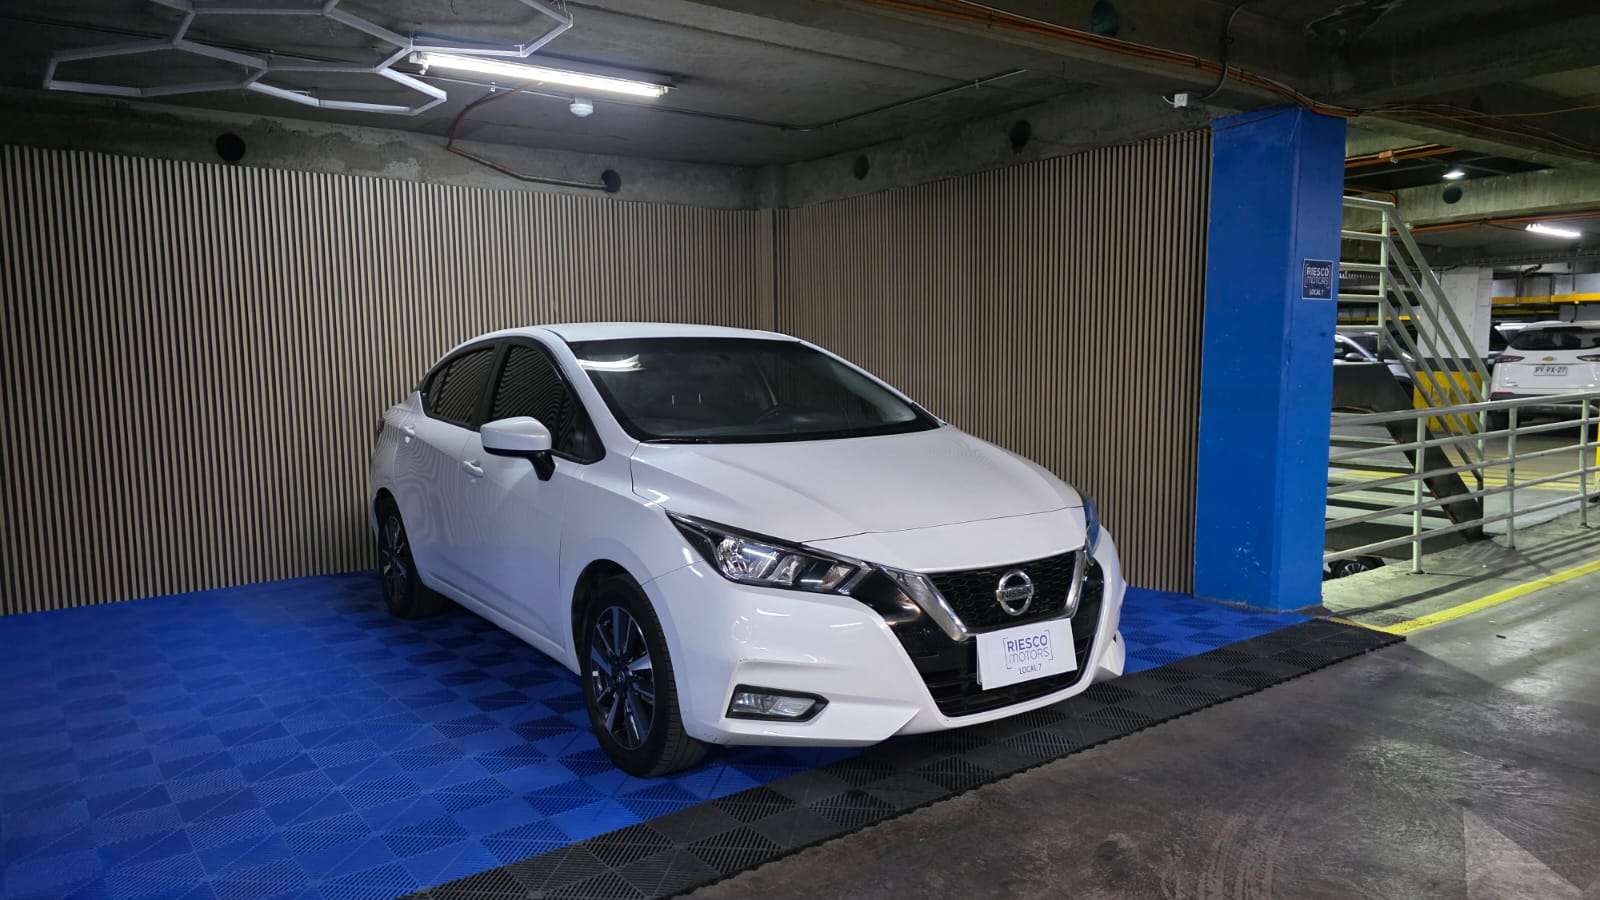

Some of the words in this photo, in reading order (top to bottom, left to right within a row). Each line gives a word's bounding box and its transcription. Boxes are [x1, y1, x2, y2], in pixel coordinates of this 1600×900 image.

[1306, 267, 1329, 276] RIESCO
[1007, 635, 1048, 652] RIESCO
[1019, 664, 1038, 675] LOCAL
